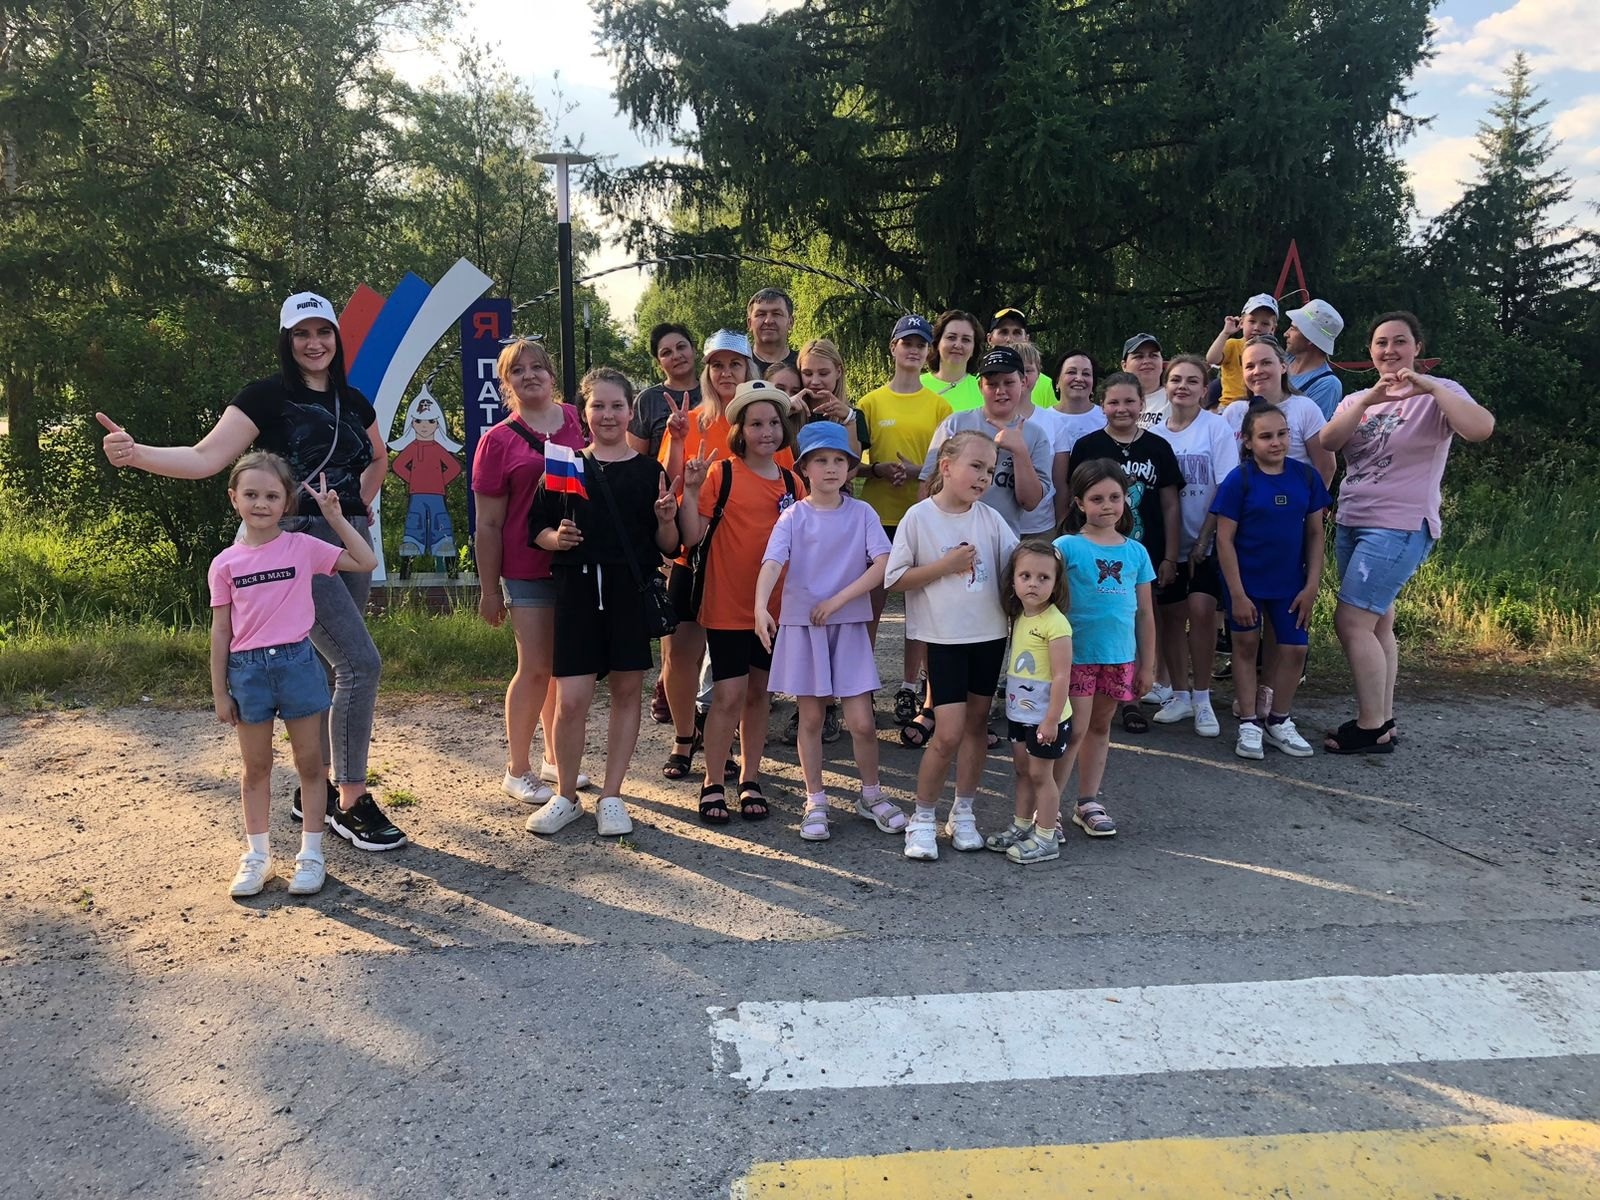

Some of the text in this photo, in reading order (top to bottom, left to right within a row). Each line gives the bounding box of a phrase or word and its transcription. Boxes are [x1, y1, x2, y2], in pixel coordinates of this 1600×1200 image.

[296, 301, 318, 310] PUMA
[472, 311, 499, 339] Я
[1180, 489, 1204, 497] ORK
[267, 571, 291, 579] МАТЬ
